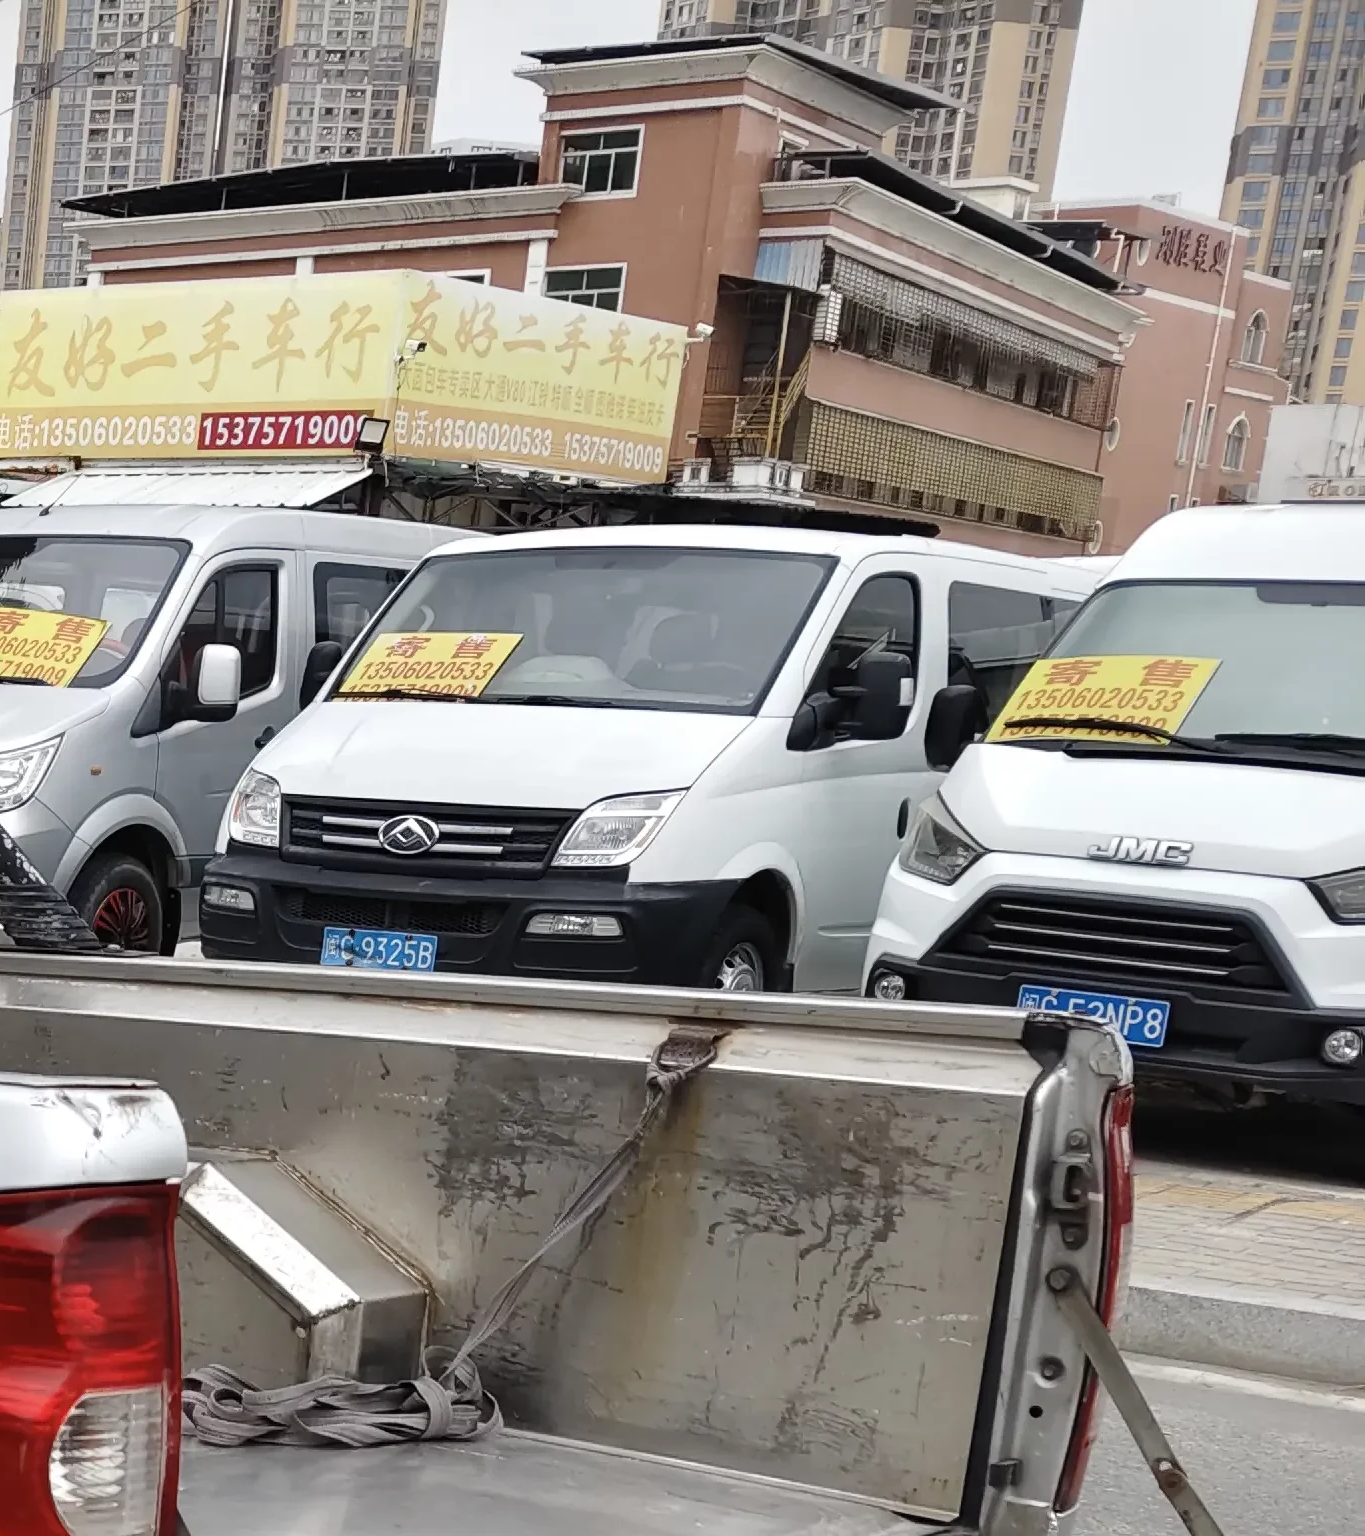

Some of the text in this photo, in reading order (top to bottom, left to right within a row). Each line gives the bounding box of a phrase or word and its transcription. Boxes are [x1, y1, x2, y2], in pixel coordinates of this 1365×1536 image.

[7, 296, 382, 399] 友好二手车行
[406, 279, 680, 391] 友好二手车行
[563, 431, 664, 474] 15375719009
[385, 635, 498, 660] 寄售
[358, 661, 495, 681] 13506020533
[1043, 659, 1199, 689] 寄售
[1016, 687, 1186, 713] 13506020533
[1087, 835, 1193, 866] JMC
